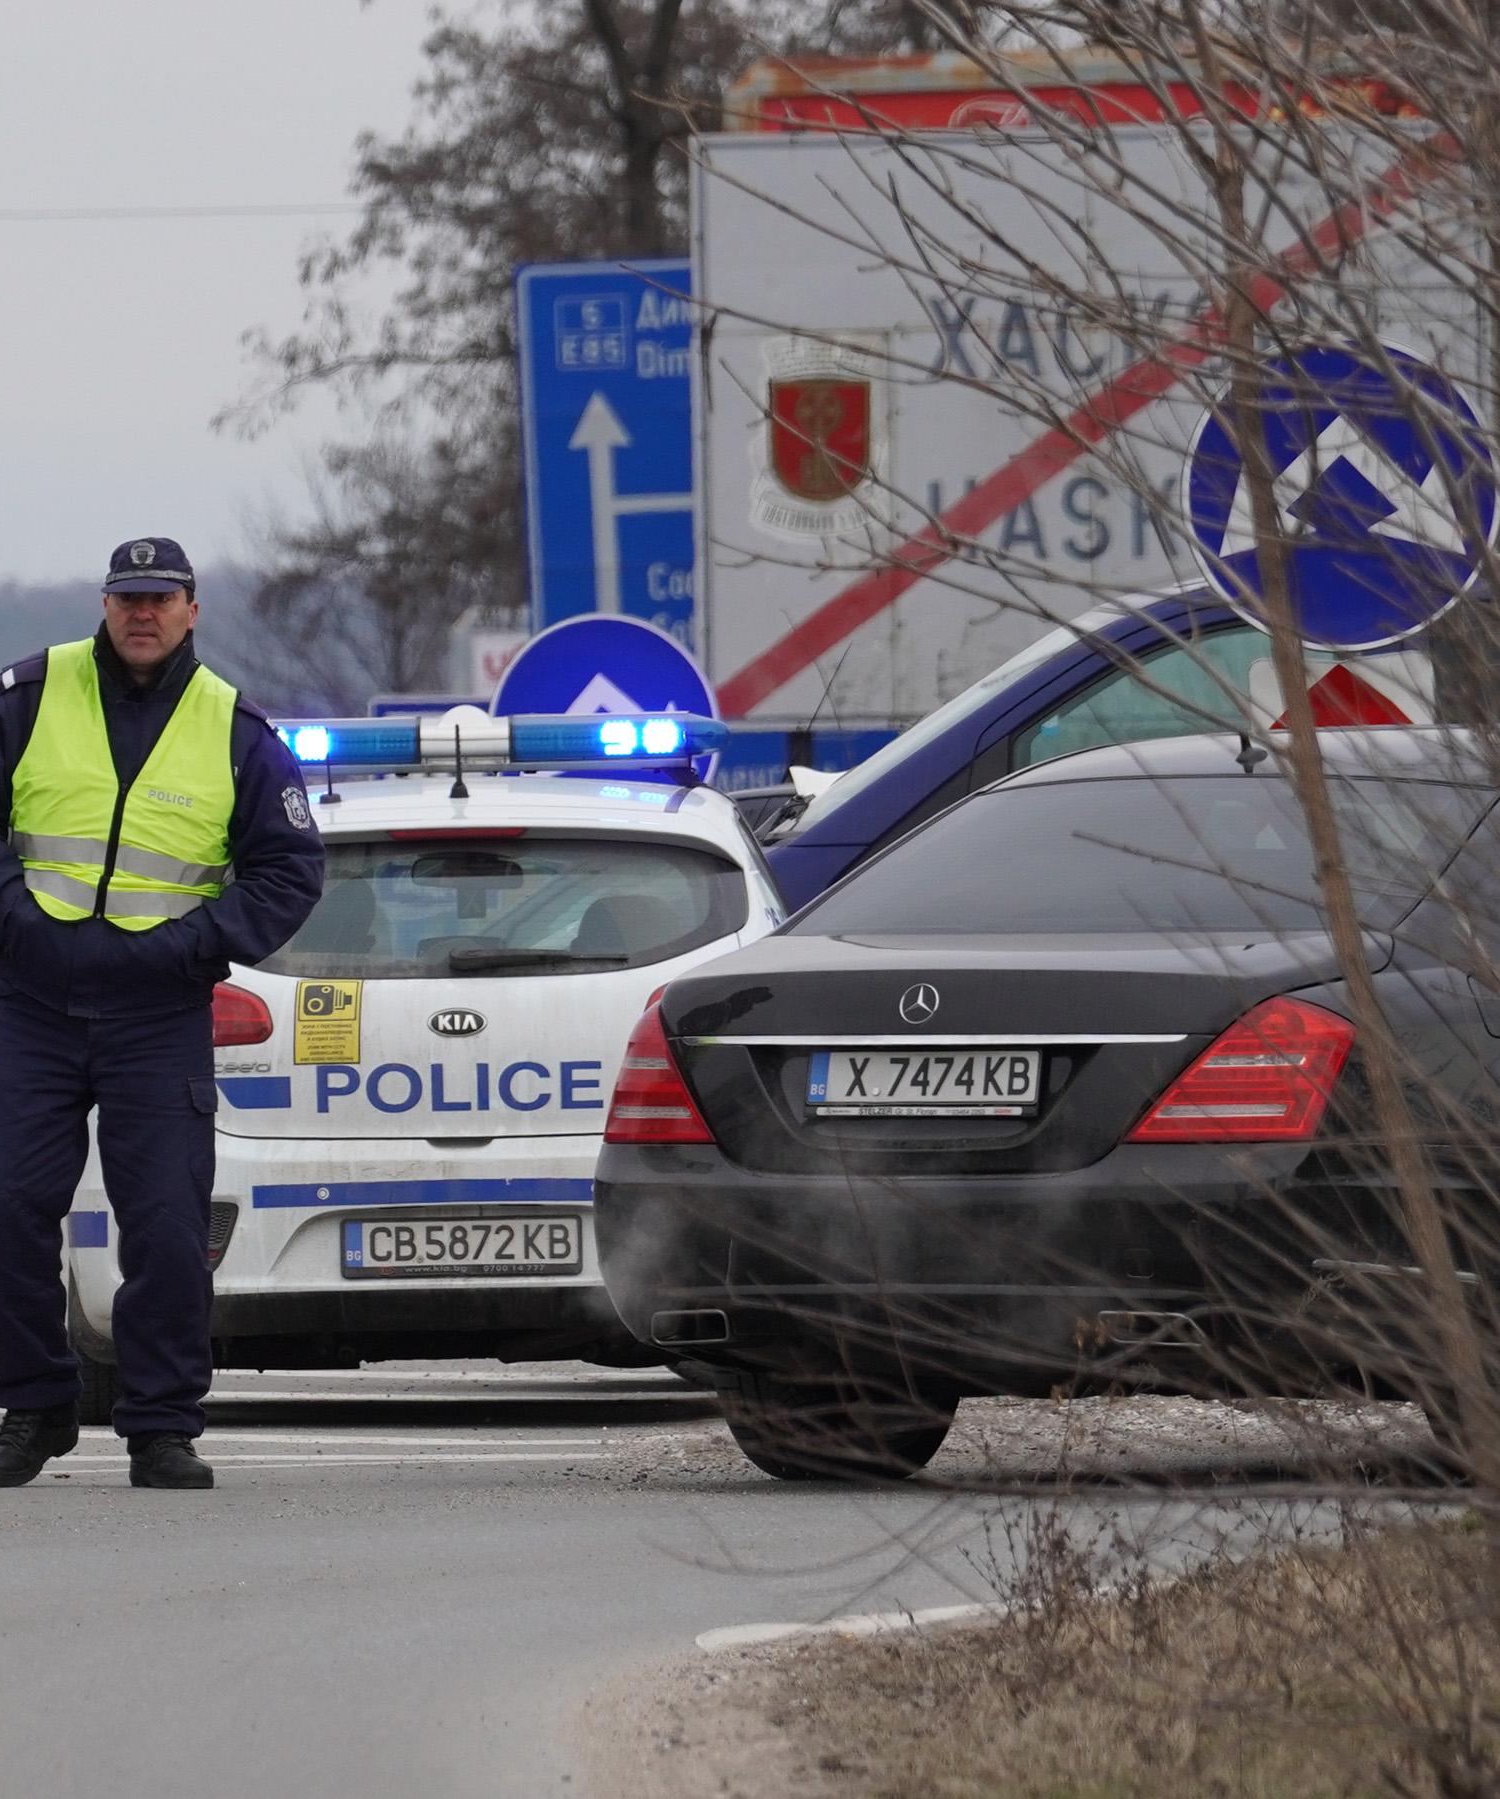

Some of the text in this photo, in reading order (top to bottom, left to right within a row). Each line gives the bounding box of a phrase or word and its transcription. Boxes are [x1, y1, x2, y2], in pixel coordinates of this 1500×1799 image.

[148, 789, 193, 808] POLICE
[437, 1013, 478, 1031] KIA
[316, 1060, 604, 1114] POLICE
[810, 1083, 826, 1096] BG
[346, 1251, 362, 1261] BG
[404, 1264, 468, 1273] www.kia.bg
